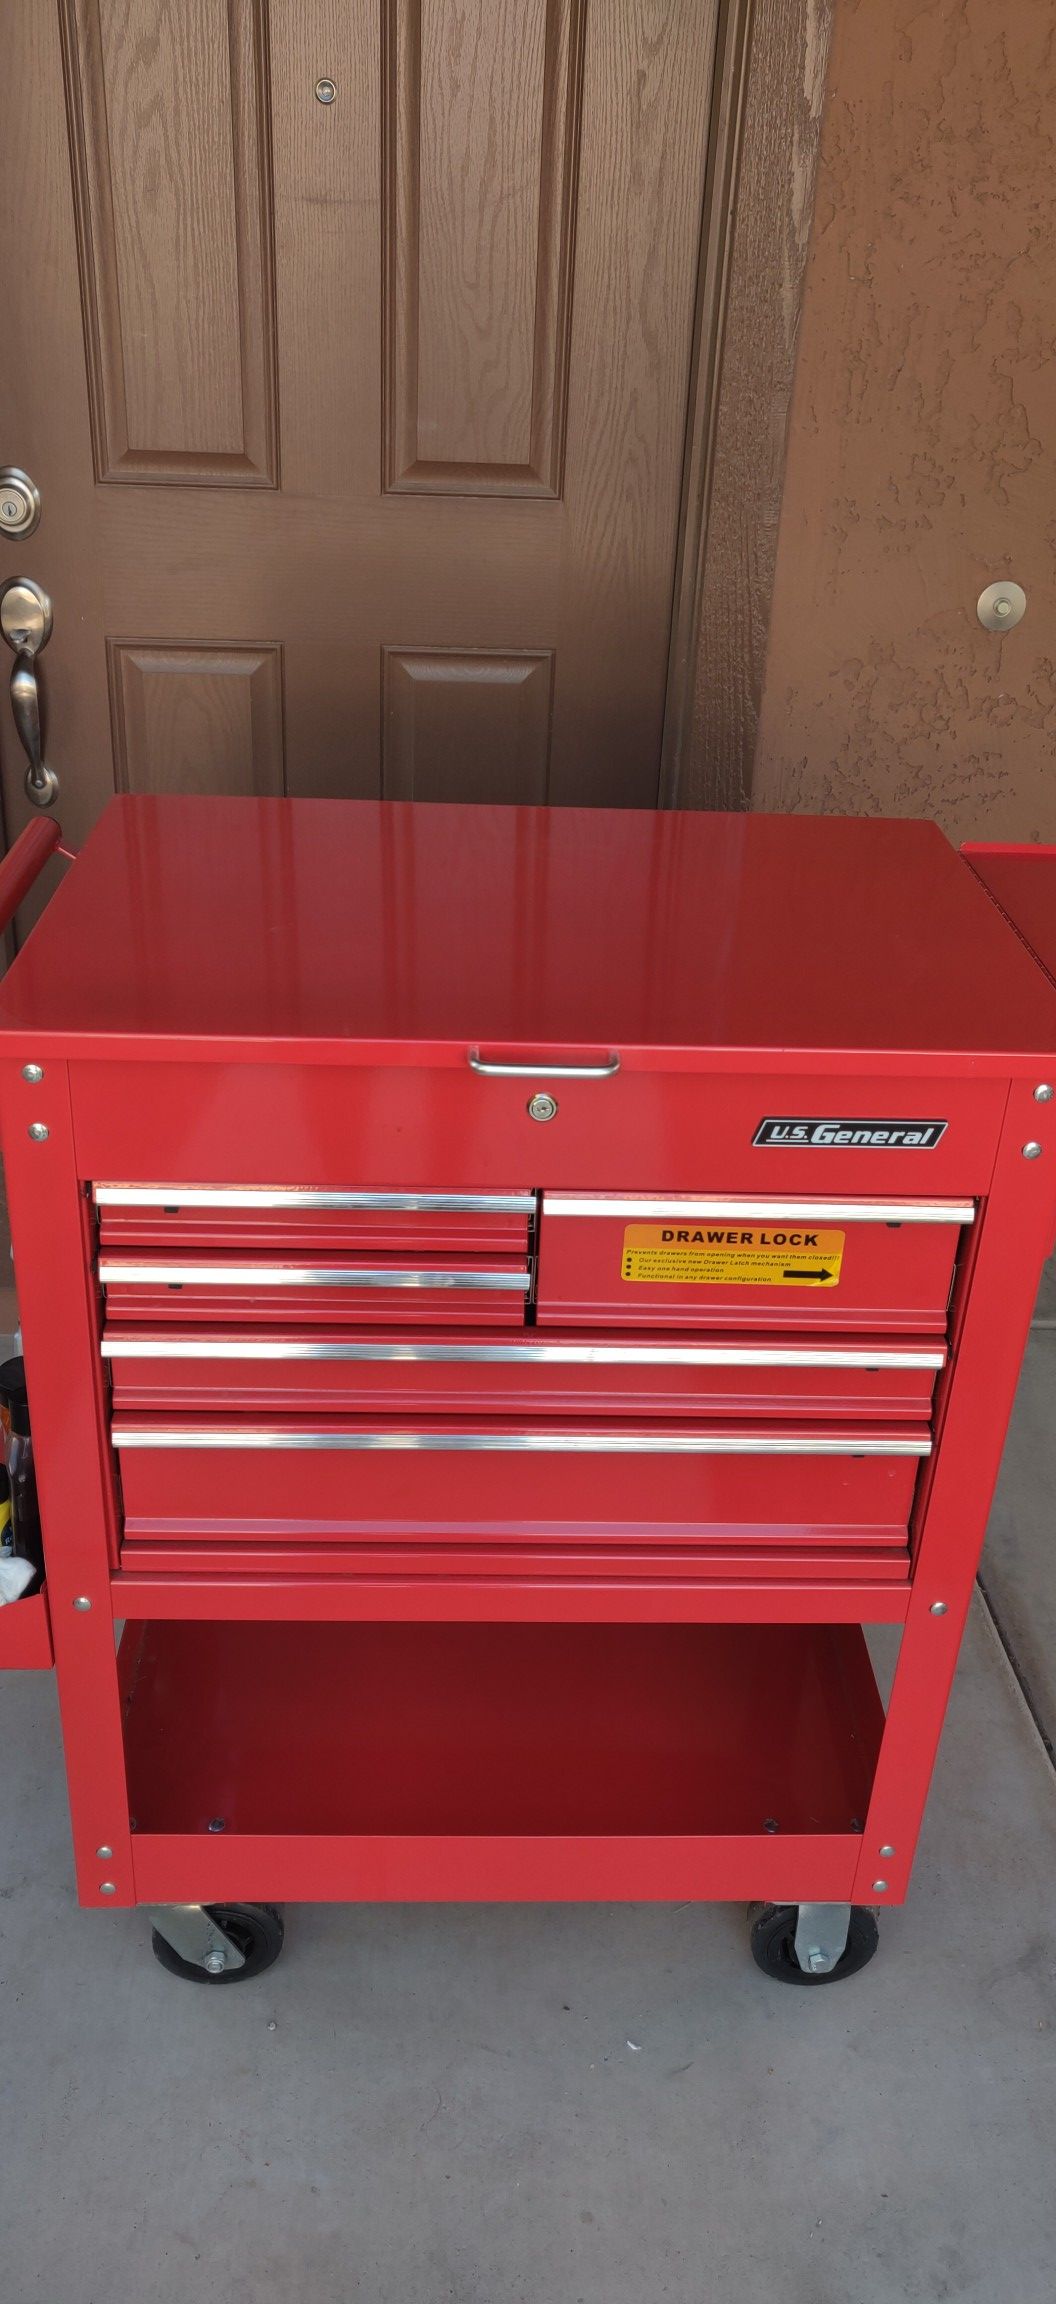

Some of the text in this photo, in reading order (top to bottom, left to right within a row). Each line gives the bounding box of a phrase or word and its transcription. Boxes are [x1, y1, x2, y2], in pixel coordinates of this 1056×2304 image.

[811, 1124, 935, 1145] General
[661, 1229, 820, 1247] DRAWER LOCK
[706, 1251, 736, 1259] opening
